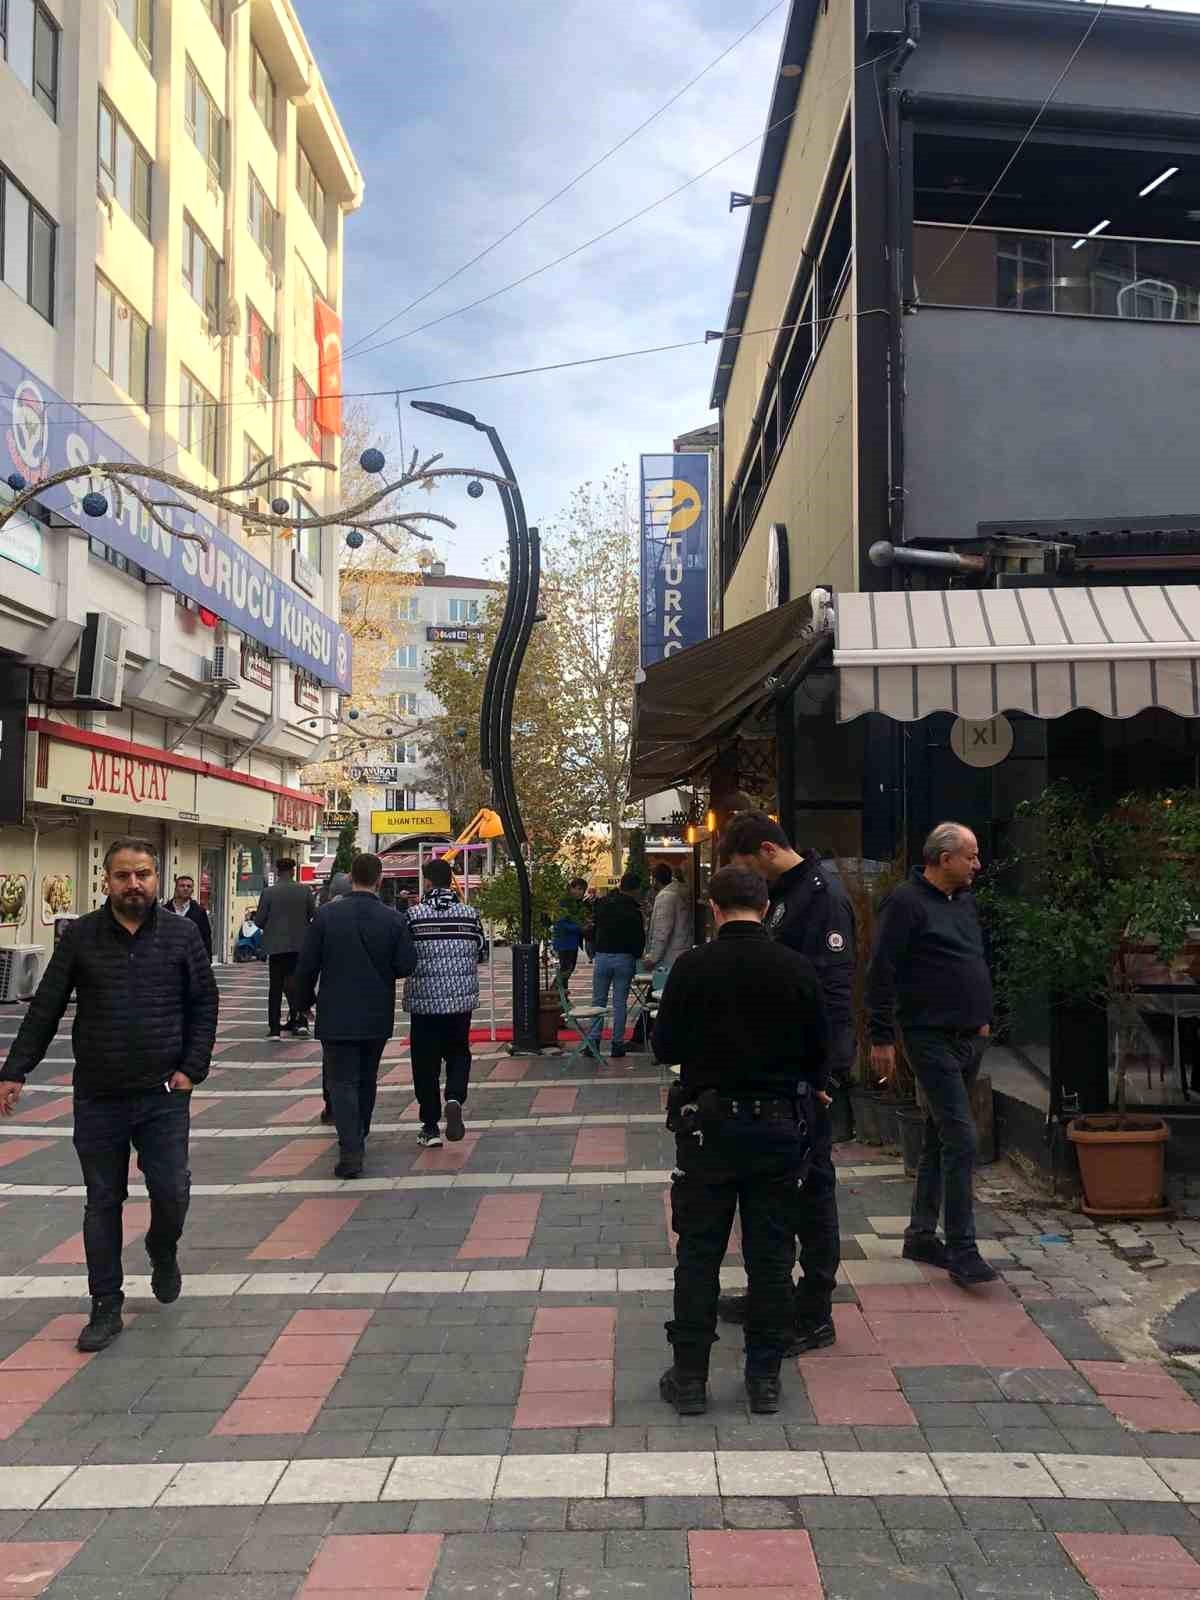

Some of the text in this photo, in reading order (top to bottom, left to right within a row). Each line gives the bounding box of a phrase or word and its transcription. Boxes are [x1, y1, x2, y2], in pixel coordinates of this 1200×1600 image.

[182, 520, 275, 629] SÜRÜCÜ
[280, 597, 331, 665] KURSU
[88, 751, 169, 803] MERTAY
